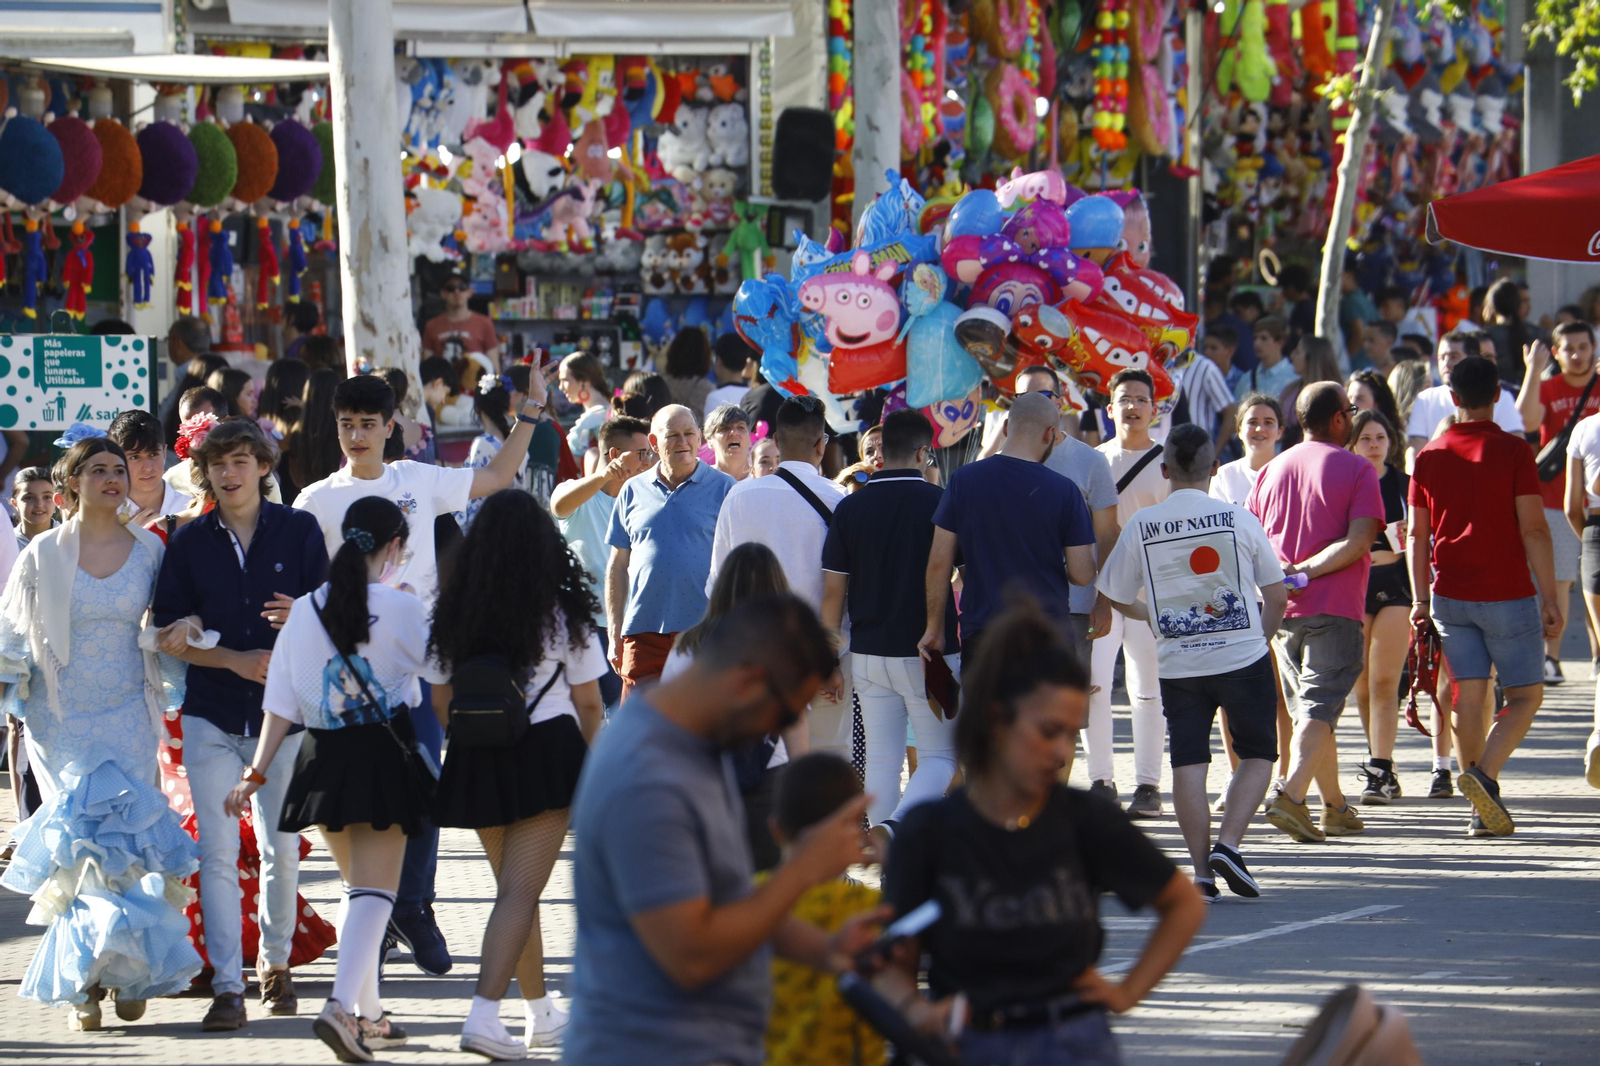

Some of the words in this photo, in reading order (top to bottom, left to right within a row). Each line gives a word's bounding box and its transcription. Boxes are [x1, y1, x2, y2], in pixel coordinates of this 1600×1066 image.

[44, 339, 62, 348] Más
[44, 348, 86, 358] papeleras
[44, 358, 60, 367] que
[44, 366, 79, 375] lunares.
[96, 407, 122, 420] sad
[1139, 521, 1160, 541] LAW
[1164, 520, 1183, 534] OF
[1187, 511, 1235, 531] NATURE
